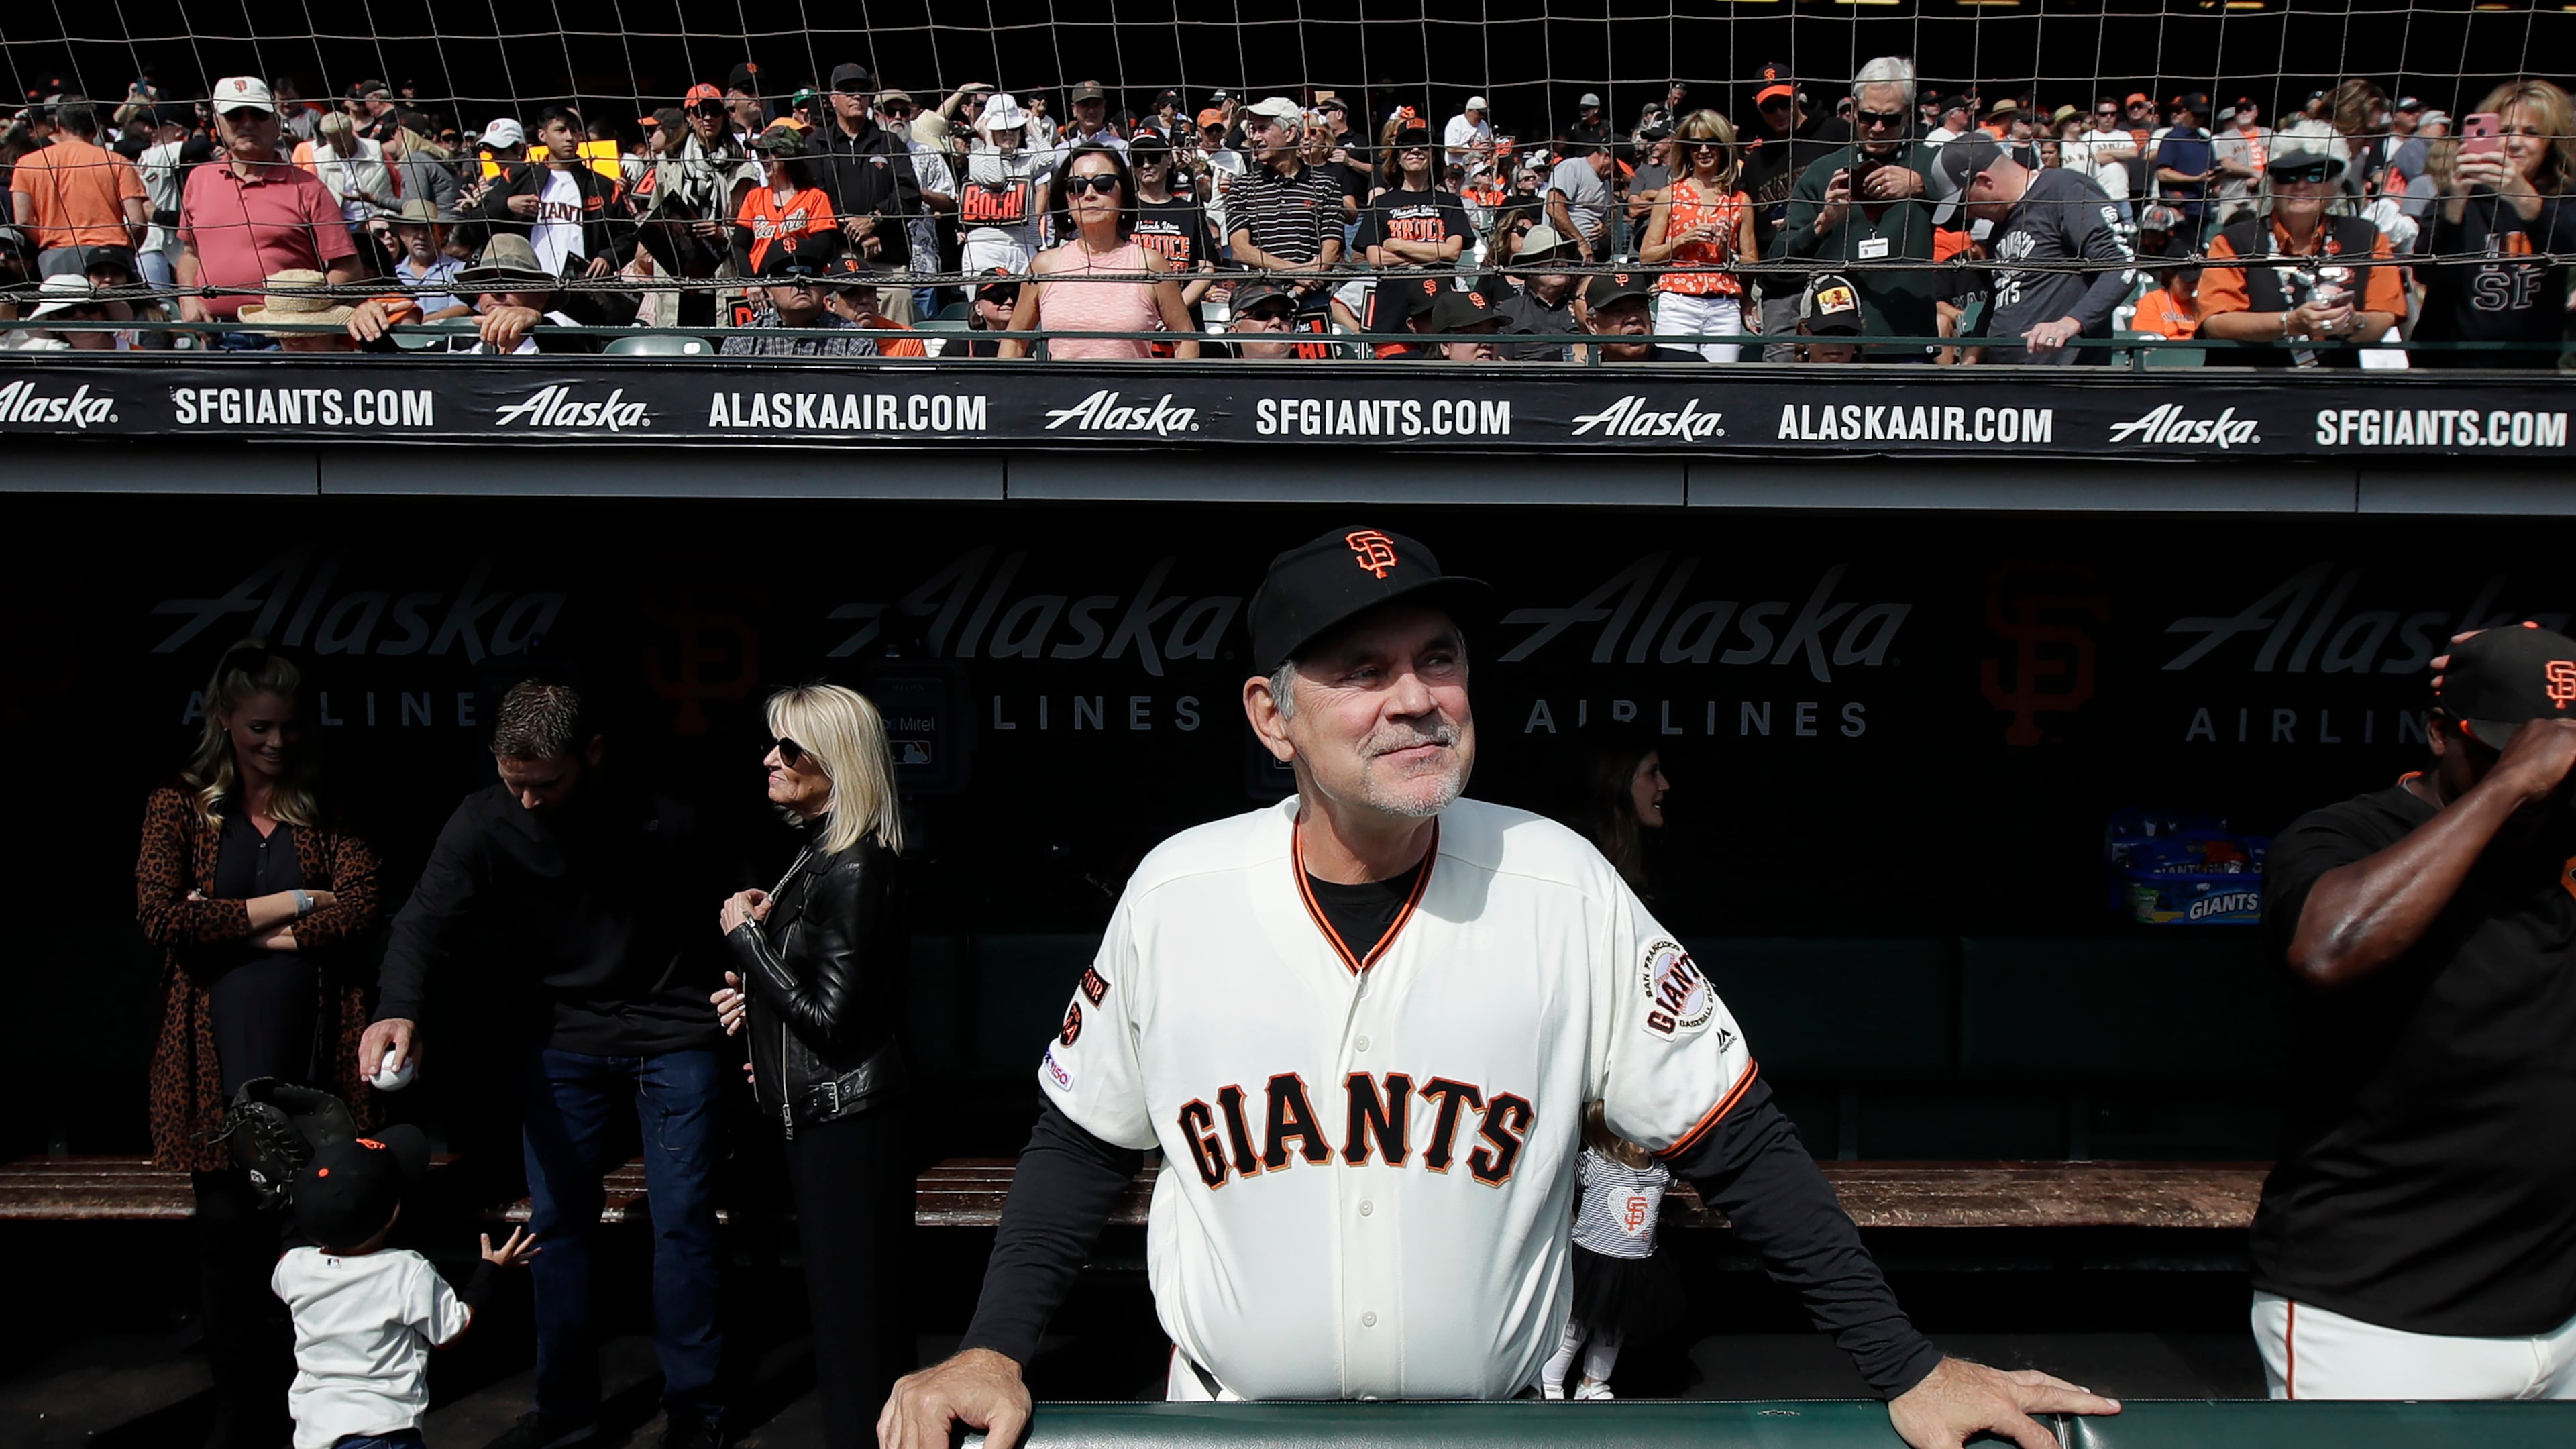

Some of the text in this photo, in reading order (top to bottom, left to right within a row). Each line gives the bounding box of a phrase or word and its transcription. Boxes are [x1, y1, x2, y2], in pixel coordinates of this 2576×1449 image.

[783, 237, 798, 254] SF
[1387, 218, 1447, 243] BRUCE
[1423, 279, 1437, 296] SF
[2471, 271, 2546, 311] SF
[174, 388, 434, 426] SFGIANTS.COM
[495, 384, 643, 431] Alaska
[709, 393, 987, 431] ALASKAAIR.COM
[1044, 390, 1191, 436] Alaska
[1256, 399, 1511, 436] SFGIANTS.COM
[1572, 396, 1715, 441] Alaska
[1778, 405, 2053, 443] ALASKAAIR.COM
[2109, 404, 2253, 449] Alaska
[2316, 409, 2568, 447] SFGIANTS.COM
[1345, 530, 1399, 580] SF
[150, 542, 569, 665] Alaska
[826, 545, 1243, 676] Alaska
[1497, 549, 1914, 684] Alaska
[2161, 560, 2575, 675] Alas
[900, 716, 934, 731] Mitel
[2184, 708, 2427, 745] AIRLIN
[2189, 893, 2259, 921] GIANTS
[1643, 941, 1680, 998] SAN FRANCISCO
[1647, 953, 1700, 1035] GIANT
[1177, 1071, 1535, 1191] GIANTS
[1625, 1197, 1648, 1230] SF
